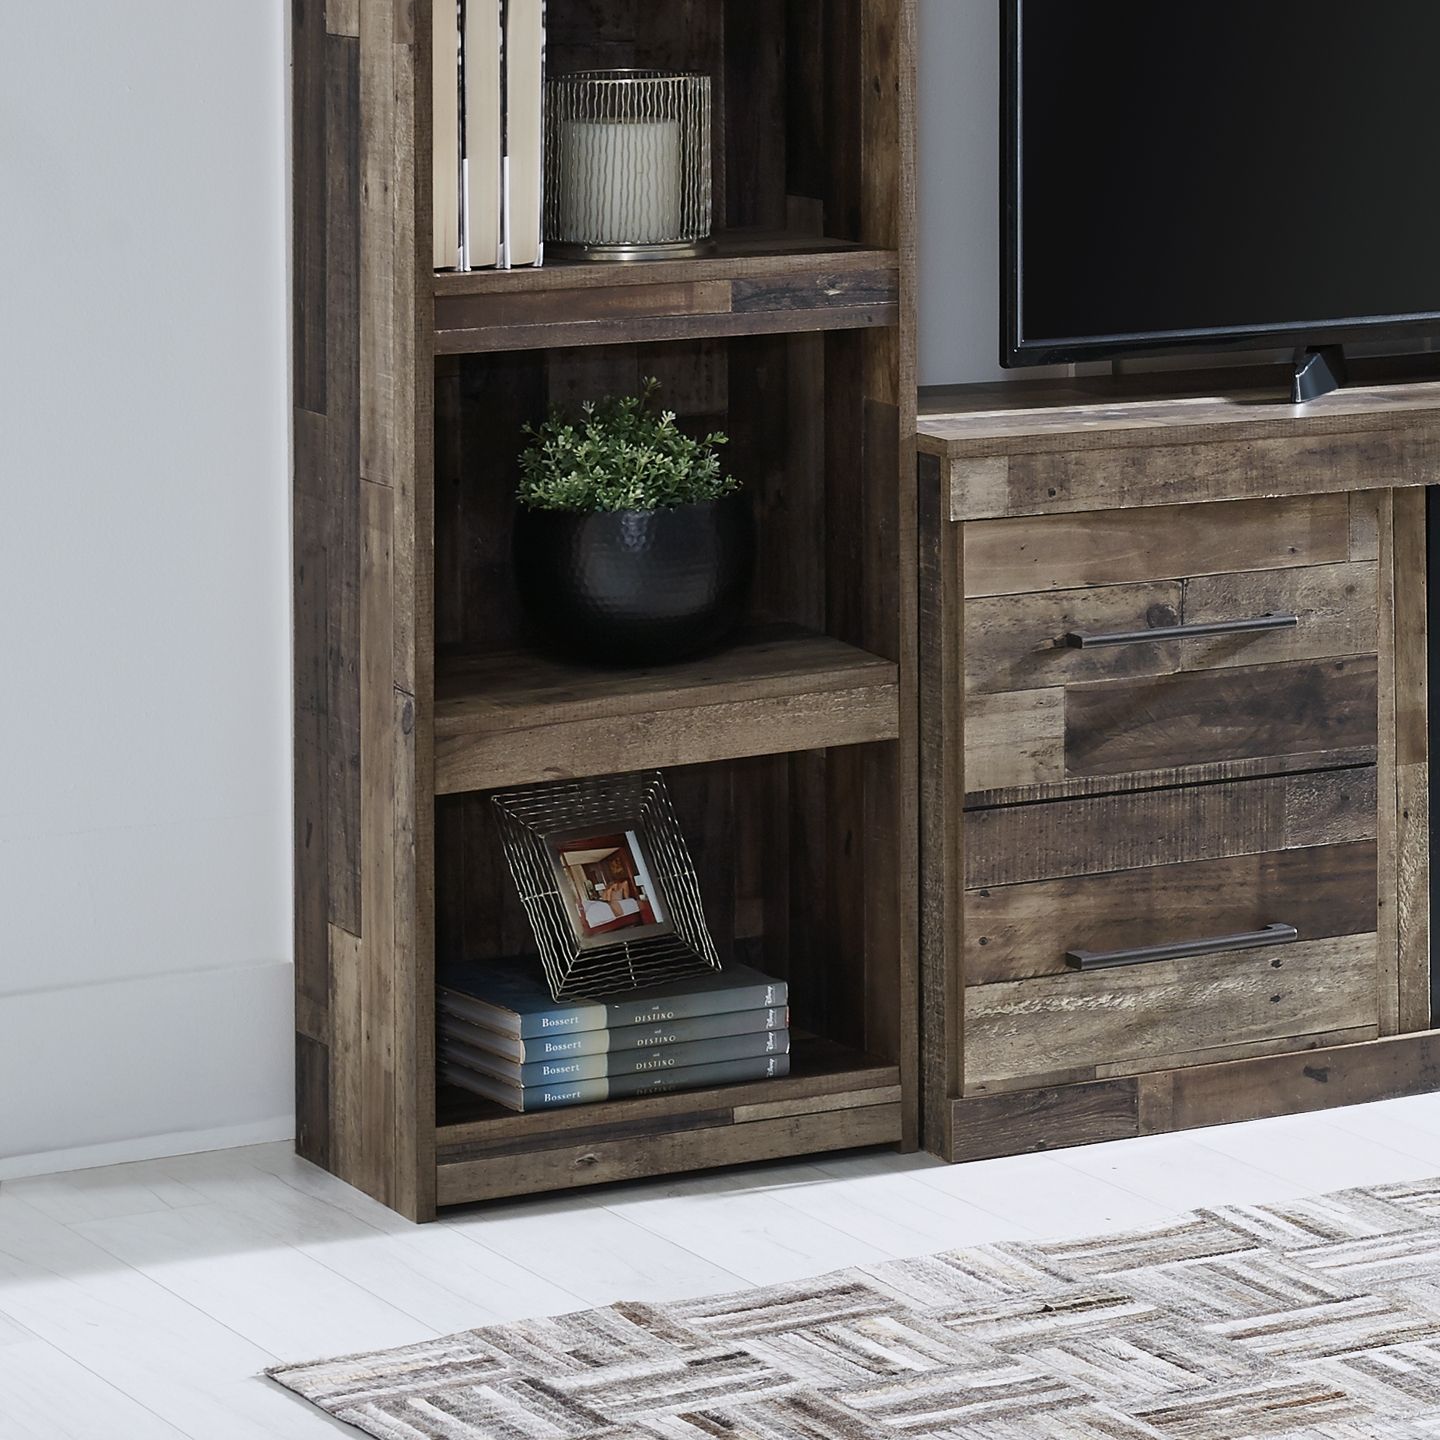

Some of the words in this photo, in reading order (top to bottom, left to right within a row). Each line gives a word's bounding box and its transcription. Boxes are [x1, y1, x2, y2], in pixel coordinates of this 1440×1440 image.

[542, 1016, 580, 1028] Bossert
[634, 1011, 674, 1023] DESTINO
[545, 1040, 582, 1053] Bossert
[637, 1035, 676, 1046] DESTINO
[543, 1064, 580, 1076] Bossert
[636, 1058, 675, 1070] DESTINO
[544, 1091, 581, 1103] Bossert
